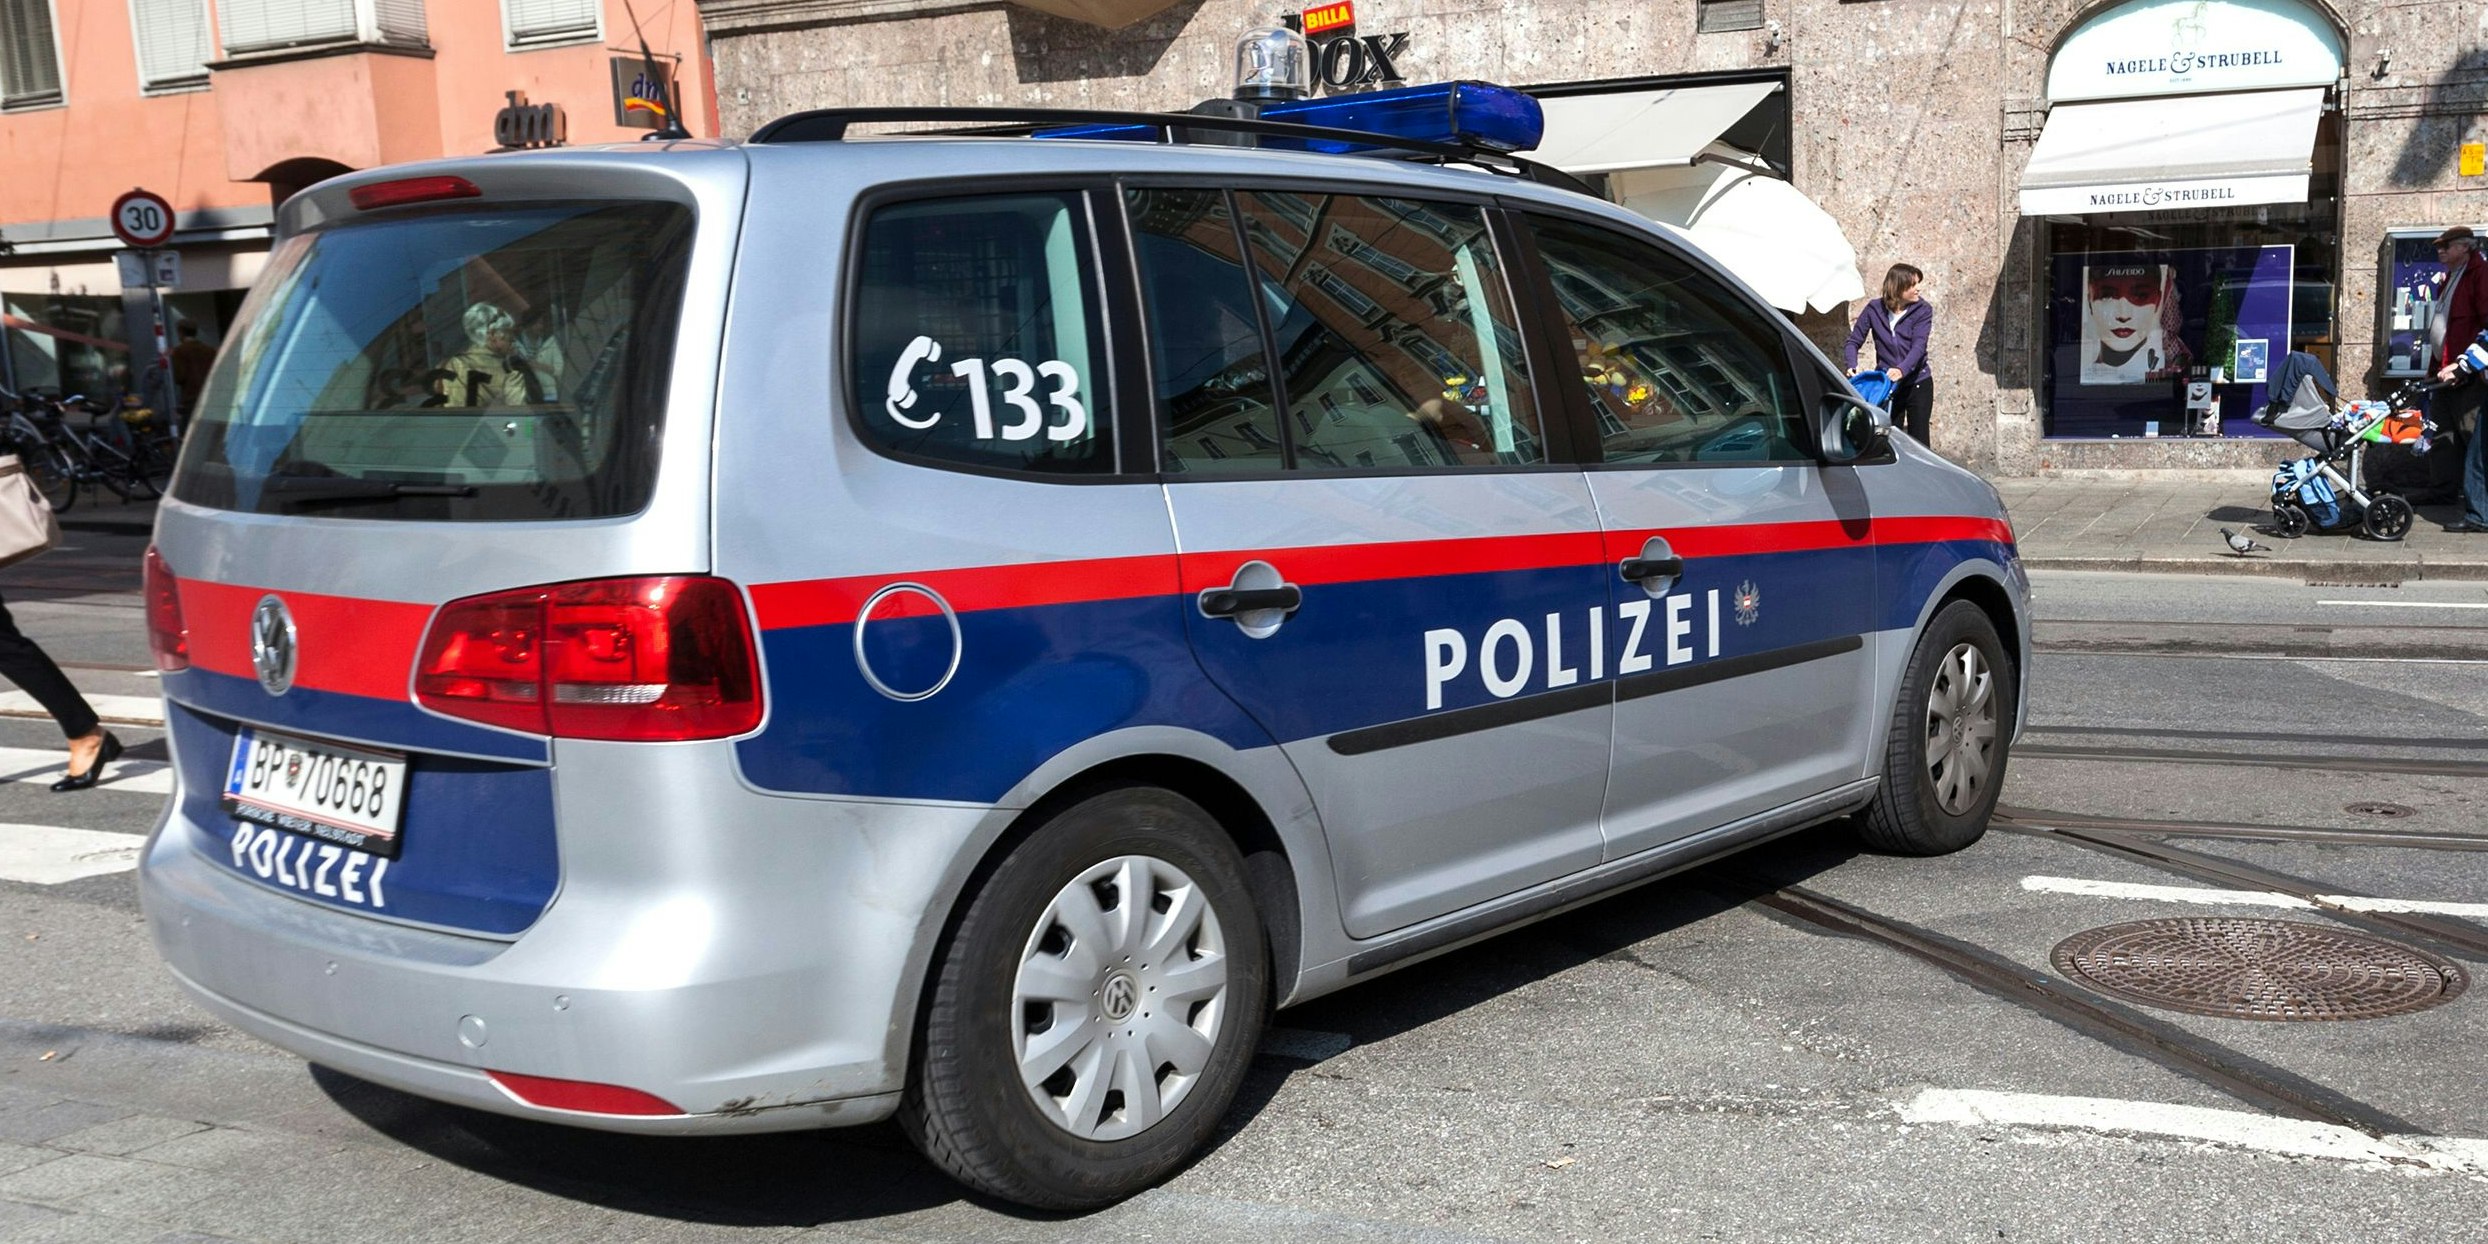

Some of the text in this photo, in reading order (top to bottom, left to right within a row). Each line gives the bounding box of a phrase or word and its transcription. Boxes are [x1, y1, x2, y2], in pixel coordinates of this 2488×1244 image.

[1305, 6, 1349, 29] BILLA
[2170, 51, 2195, 73] &
[2197, 50, 2283, 68] STRUBELL
[495, 90, 562, 146] dm
[2142, 187, 2164, 206] &
[2165, 187, 2235, 201] STRUBELL
[127, 206, 159, 231] 30
[2105, 267, 2145, 277] SHISEIDO
[951, 358, 1087, 441] 133
[1424, 588, 1720, 711] POLIZEI
[251, 740, 387, 818] BP 70668
[231, 821, 390, 908] POLIZEI
